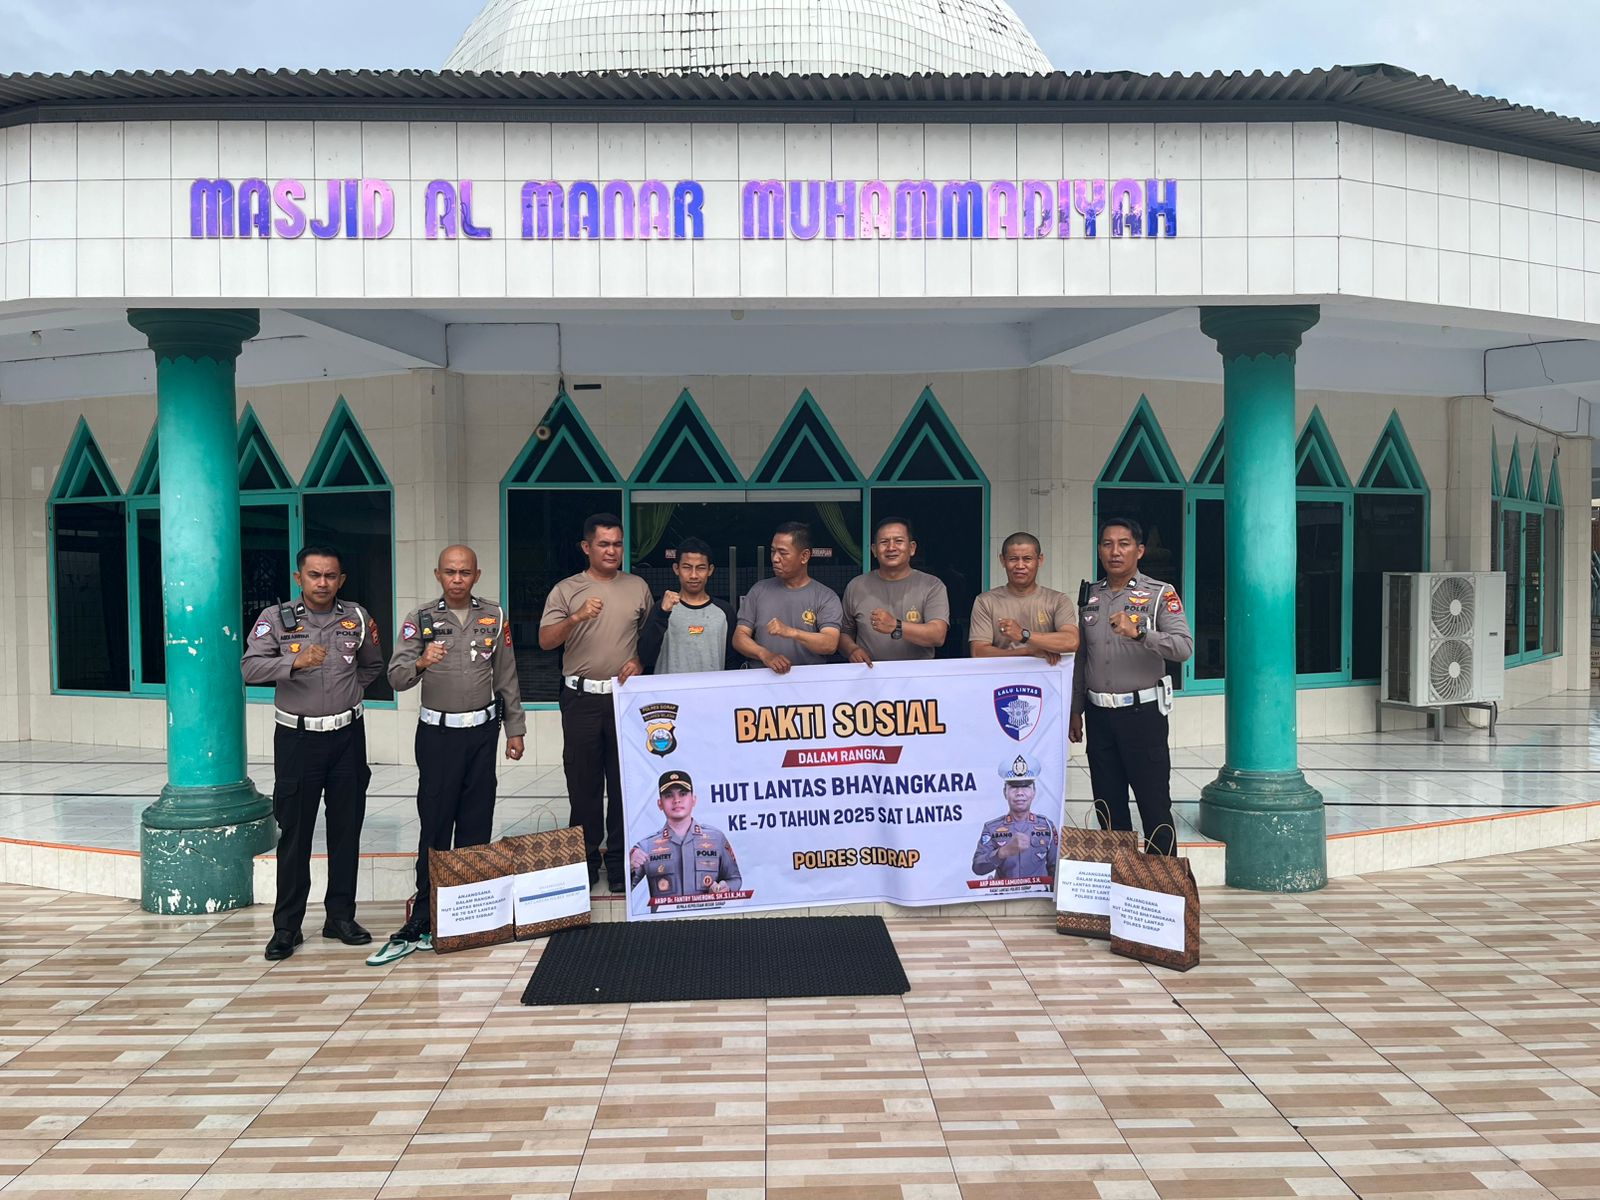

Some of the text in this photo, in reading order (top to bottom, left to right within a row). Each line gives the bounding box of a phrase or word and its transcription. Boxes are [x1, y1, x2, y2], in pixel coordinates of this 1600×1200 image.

[190, 178, 1178, 239] MASJID AL MANAR MUHAMMADIYAH
[997, 688, 1014, 696] LALU
[734, 699, 946, 743] BAKTI SOSIAL
[798, 748, 886, 764] DALAM RANGKA
[710, 772, 977, 803] HUT LANTAS BHAYANGKARA
[728, 814, 747, 832] KE
[780, 809, 830, 828] TAHUN
[833, 806, 875, 825] 2025
[878, 806, 903, 824] SAT
[906, 804, 963, 824] LANTAS
[650, 853, 672, 861] FANTRY
[793, 846, 920, 870] POLRES SIDRAP
